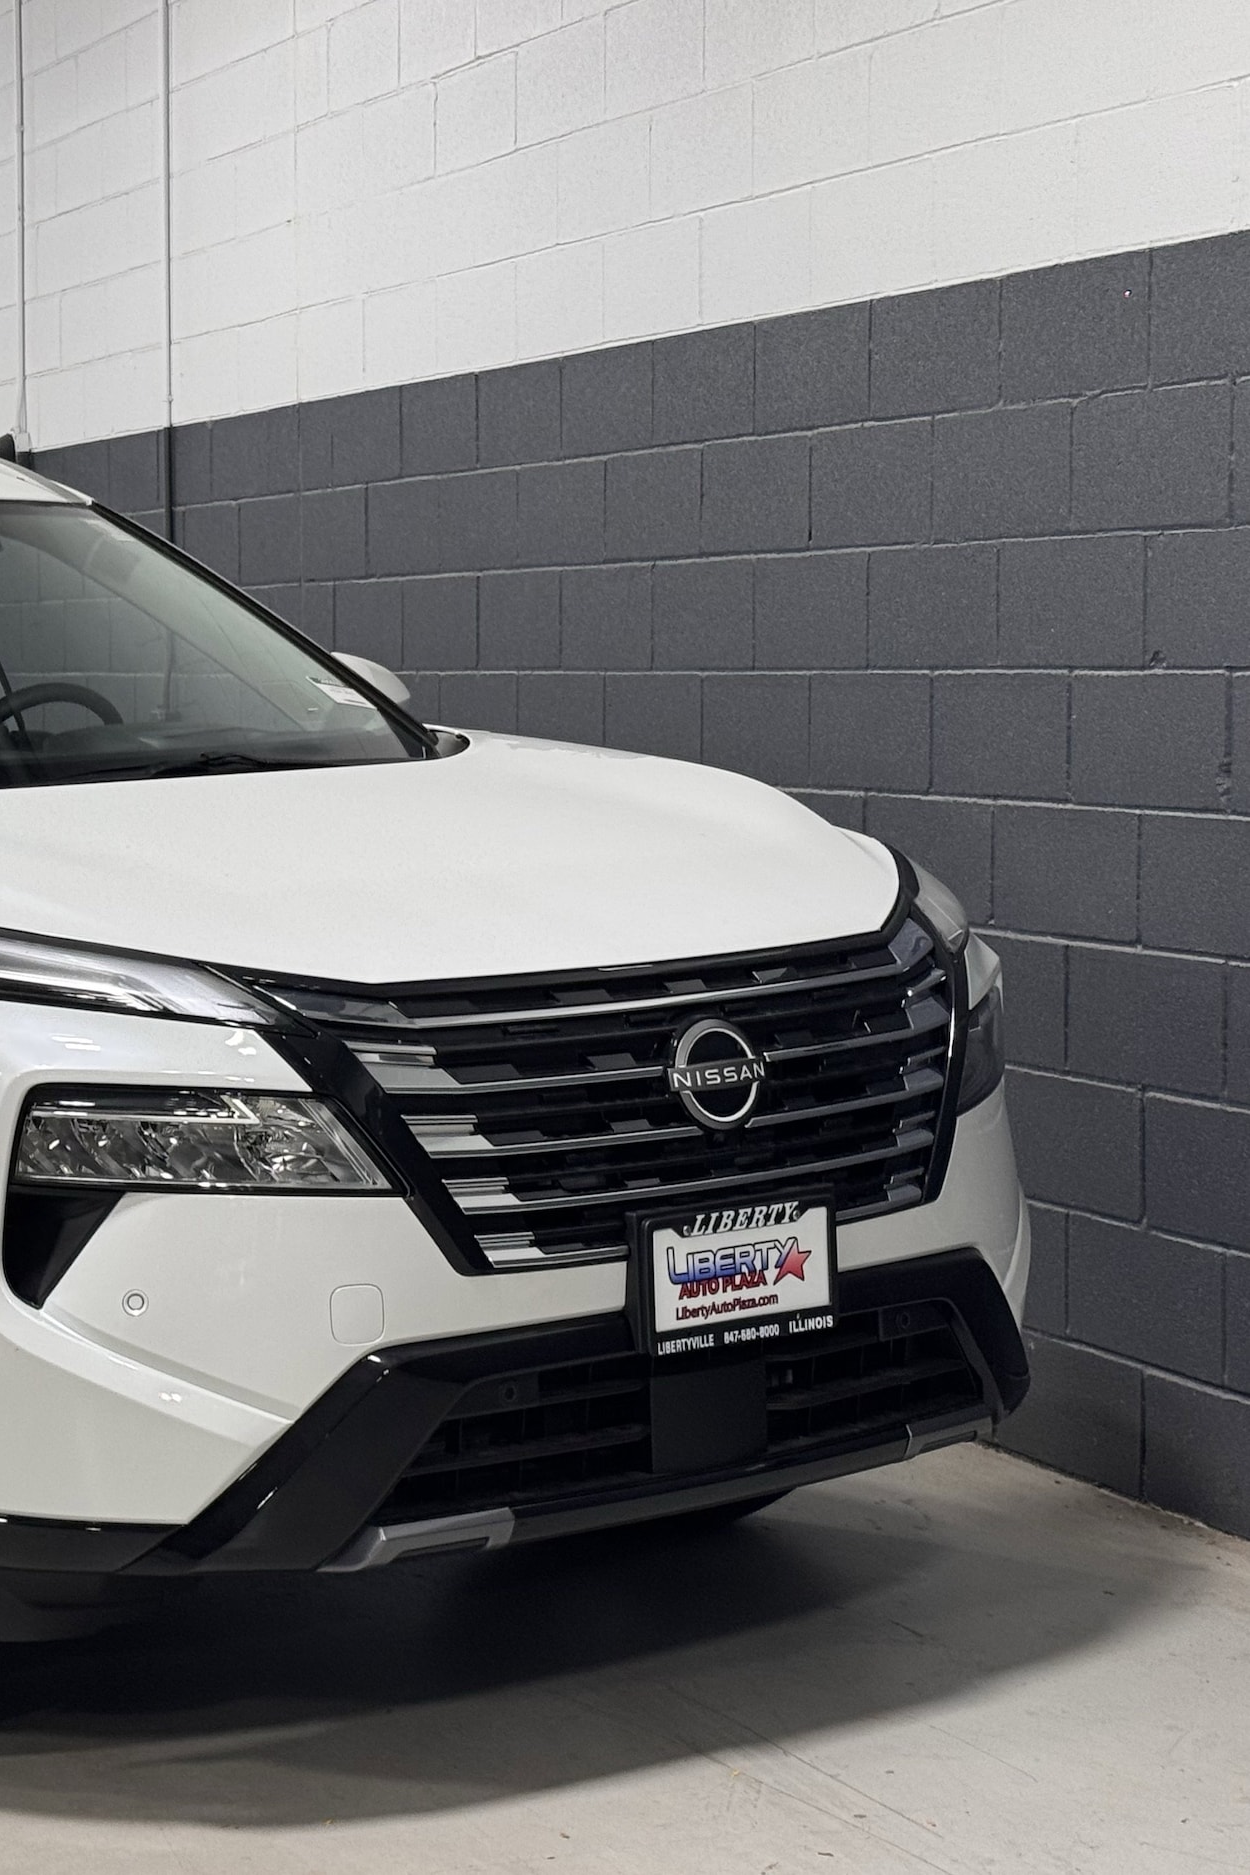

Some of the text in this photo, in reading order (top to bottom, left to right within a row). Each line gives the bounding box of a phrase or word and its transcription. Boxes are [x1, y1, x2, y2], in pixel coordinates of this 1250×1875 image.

[672, 1061, 766, 1088] NISSAN
[690, 1201, 799, 1237] LIBERTY
[667, 1236, 799, 1285] LIBERTY
[678, 1270, 767, 1300] AUTO PLAZA
[657, 1334, 715, 1356] LIBERTYVILLE
[788, 1315, 834, 1334] ILLINOIS
